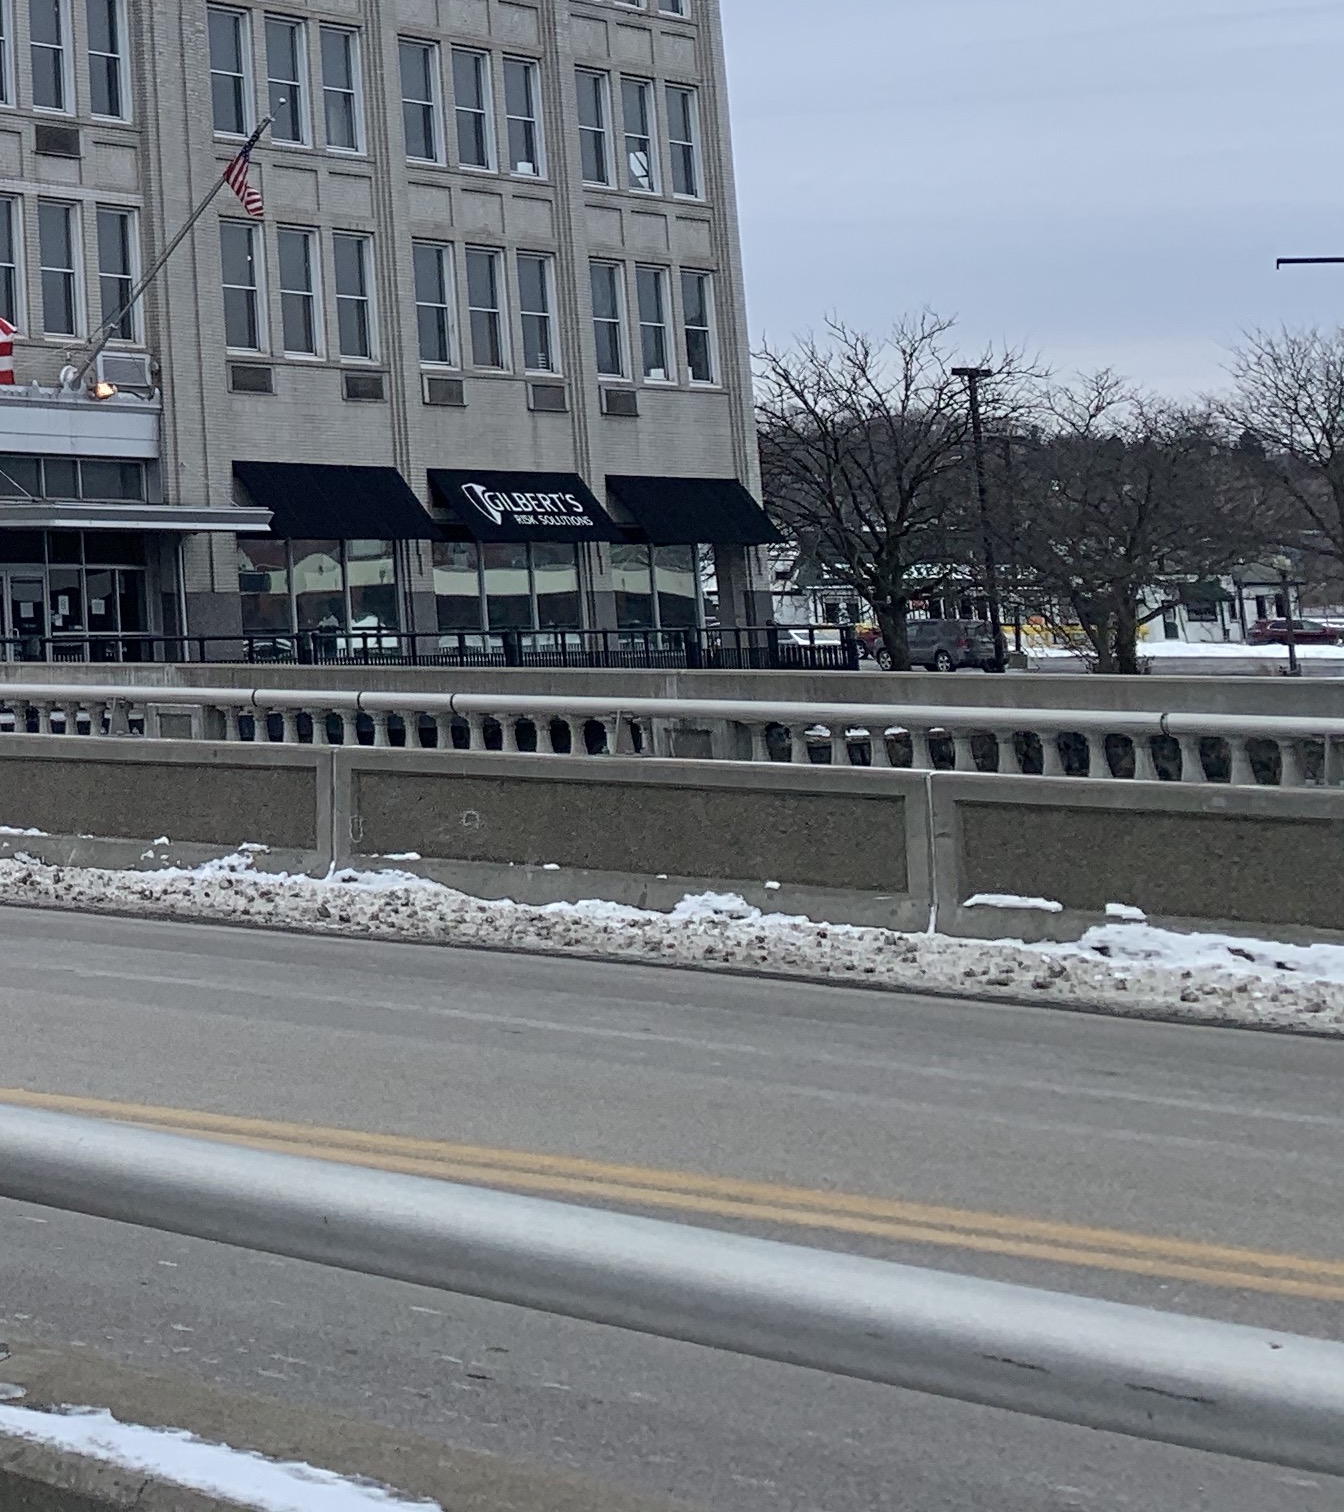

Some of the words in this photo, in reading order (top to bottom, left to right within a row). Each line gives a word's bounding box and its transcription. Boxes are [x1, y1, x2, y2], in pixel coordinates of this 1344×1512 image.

[483, 492, 584, 513] GILBERT'S
[513, 514, 538, 525] RISK
[538, 515, 594, 526] SOLUTIONS
